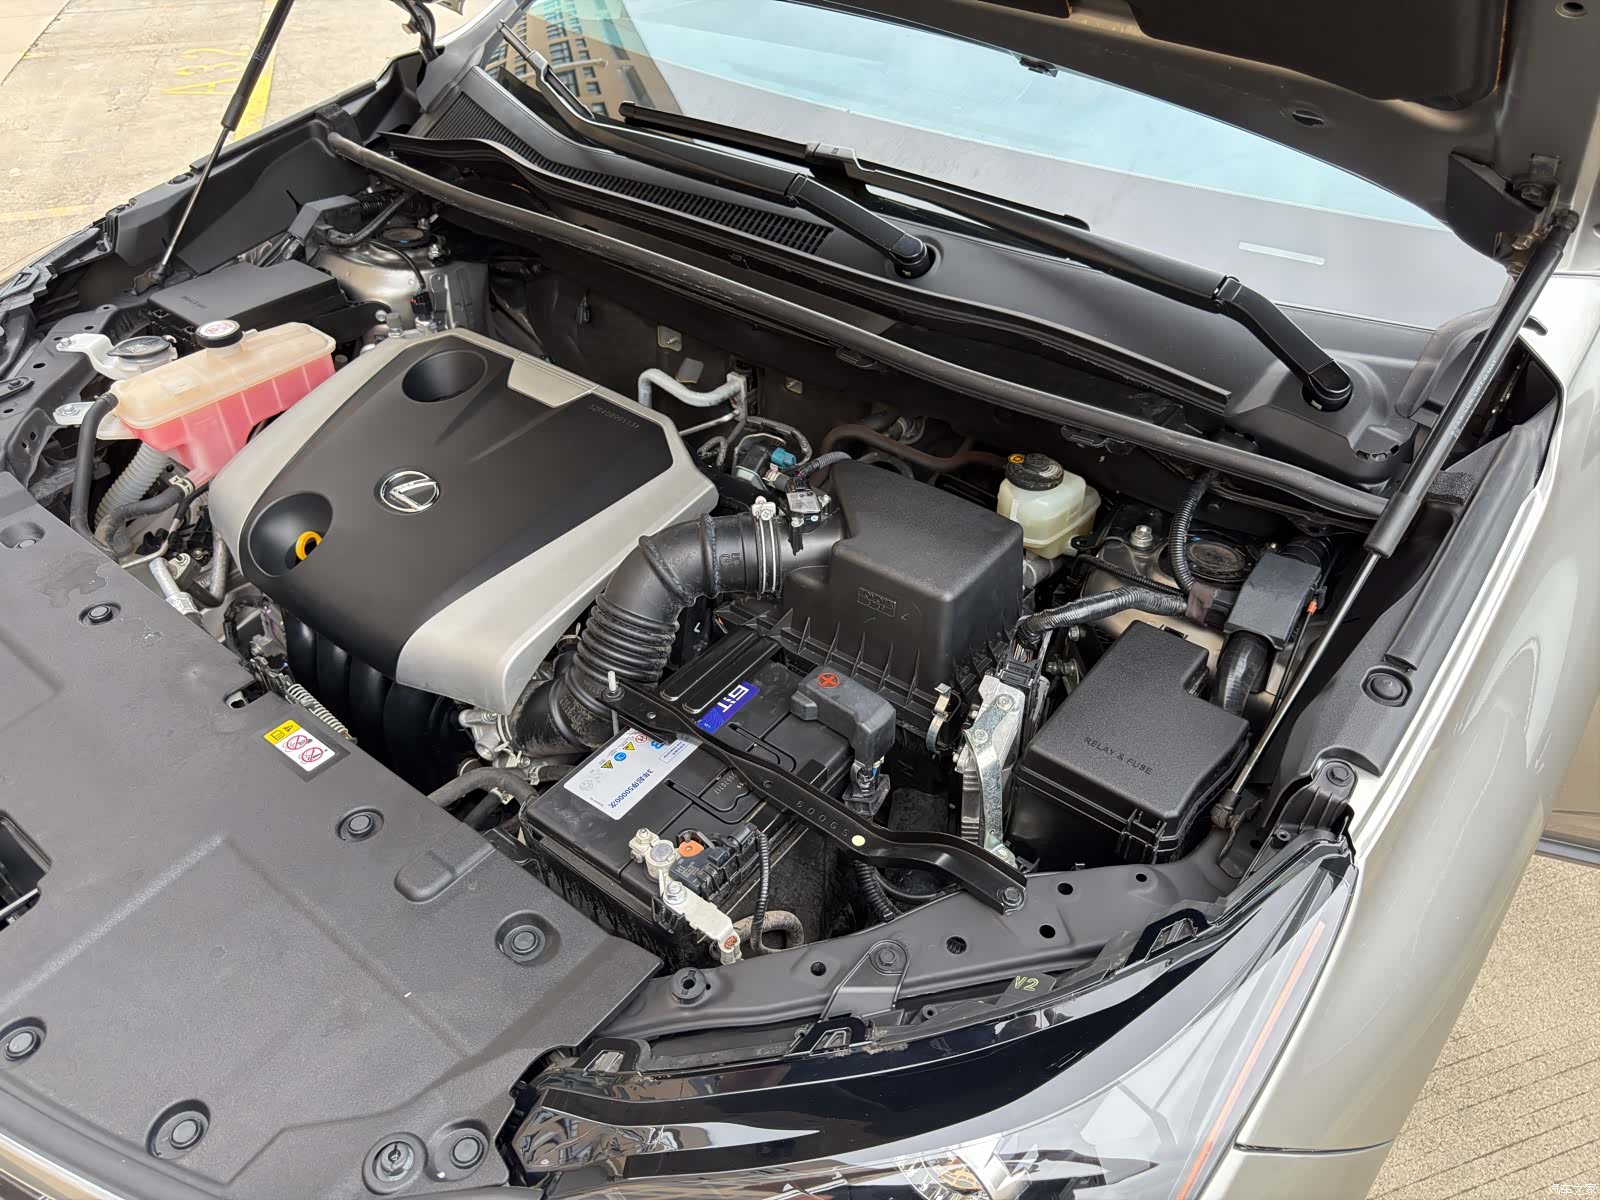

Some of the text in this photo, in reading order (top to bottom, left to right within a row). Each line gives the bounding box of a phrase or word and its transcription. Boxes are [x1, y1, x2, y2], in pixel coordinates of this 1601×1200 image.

[1083, 736, 1153, 775] RELAY & FUSE
[1014, 975, 1039, 992] V2
